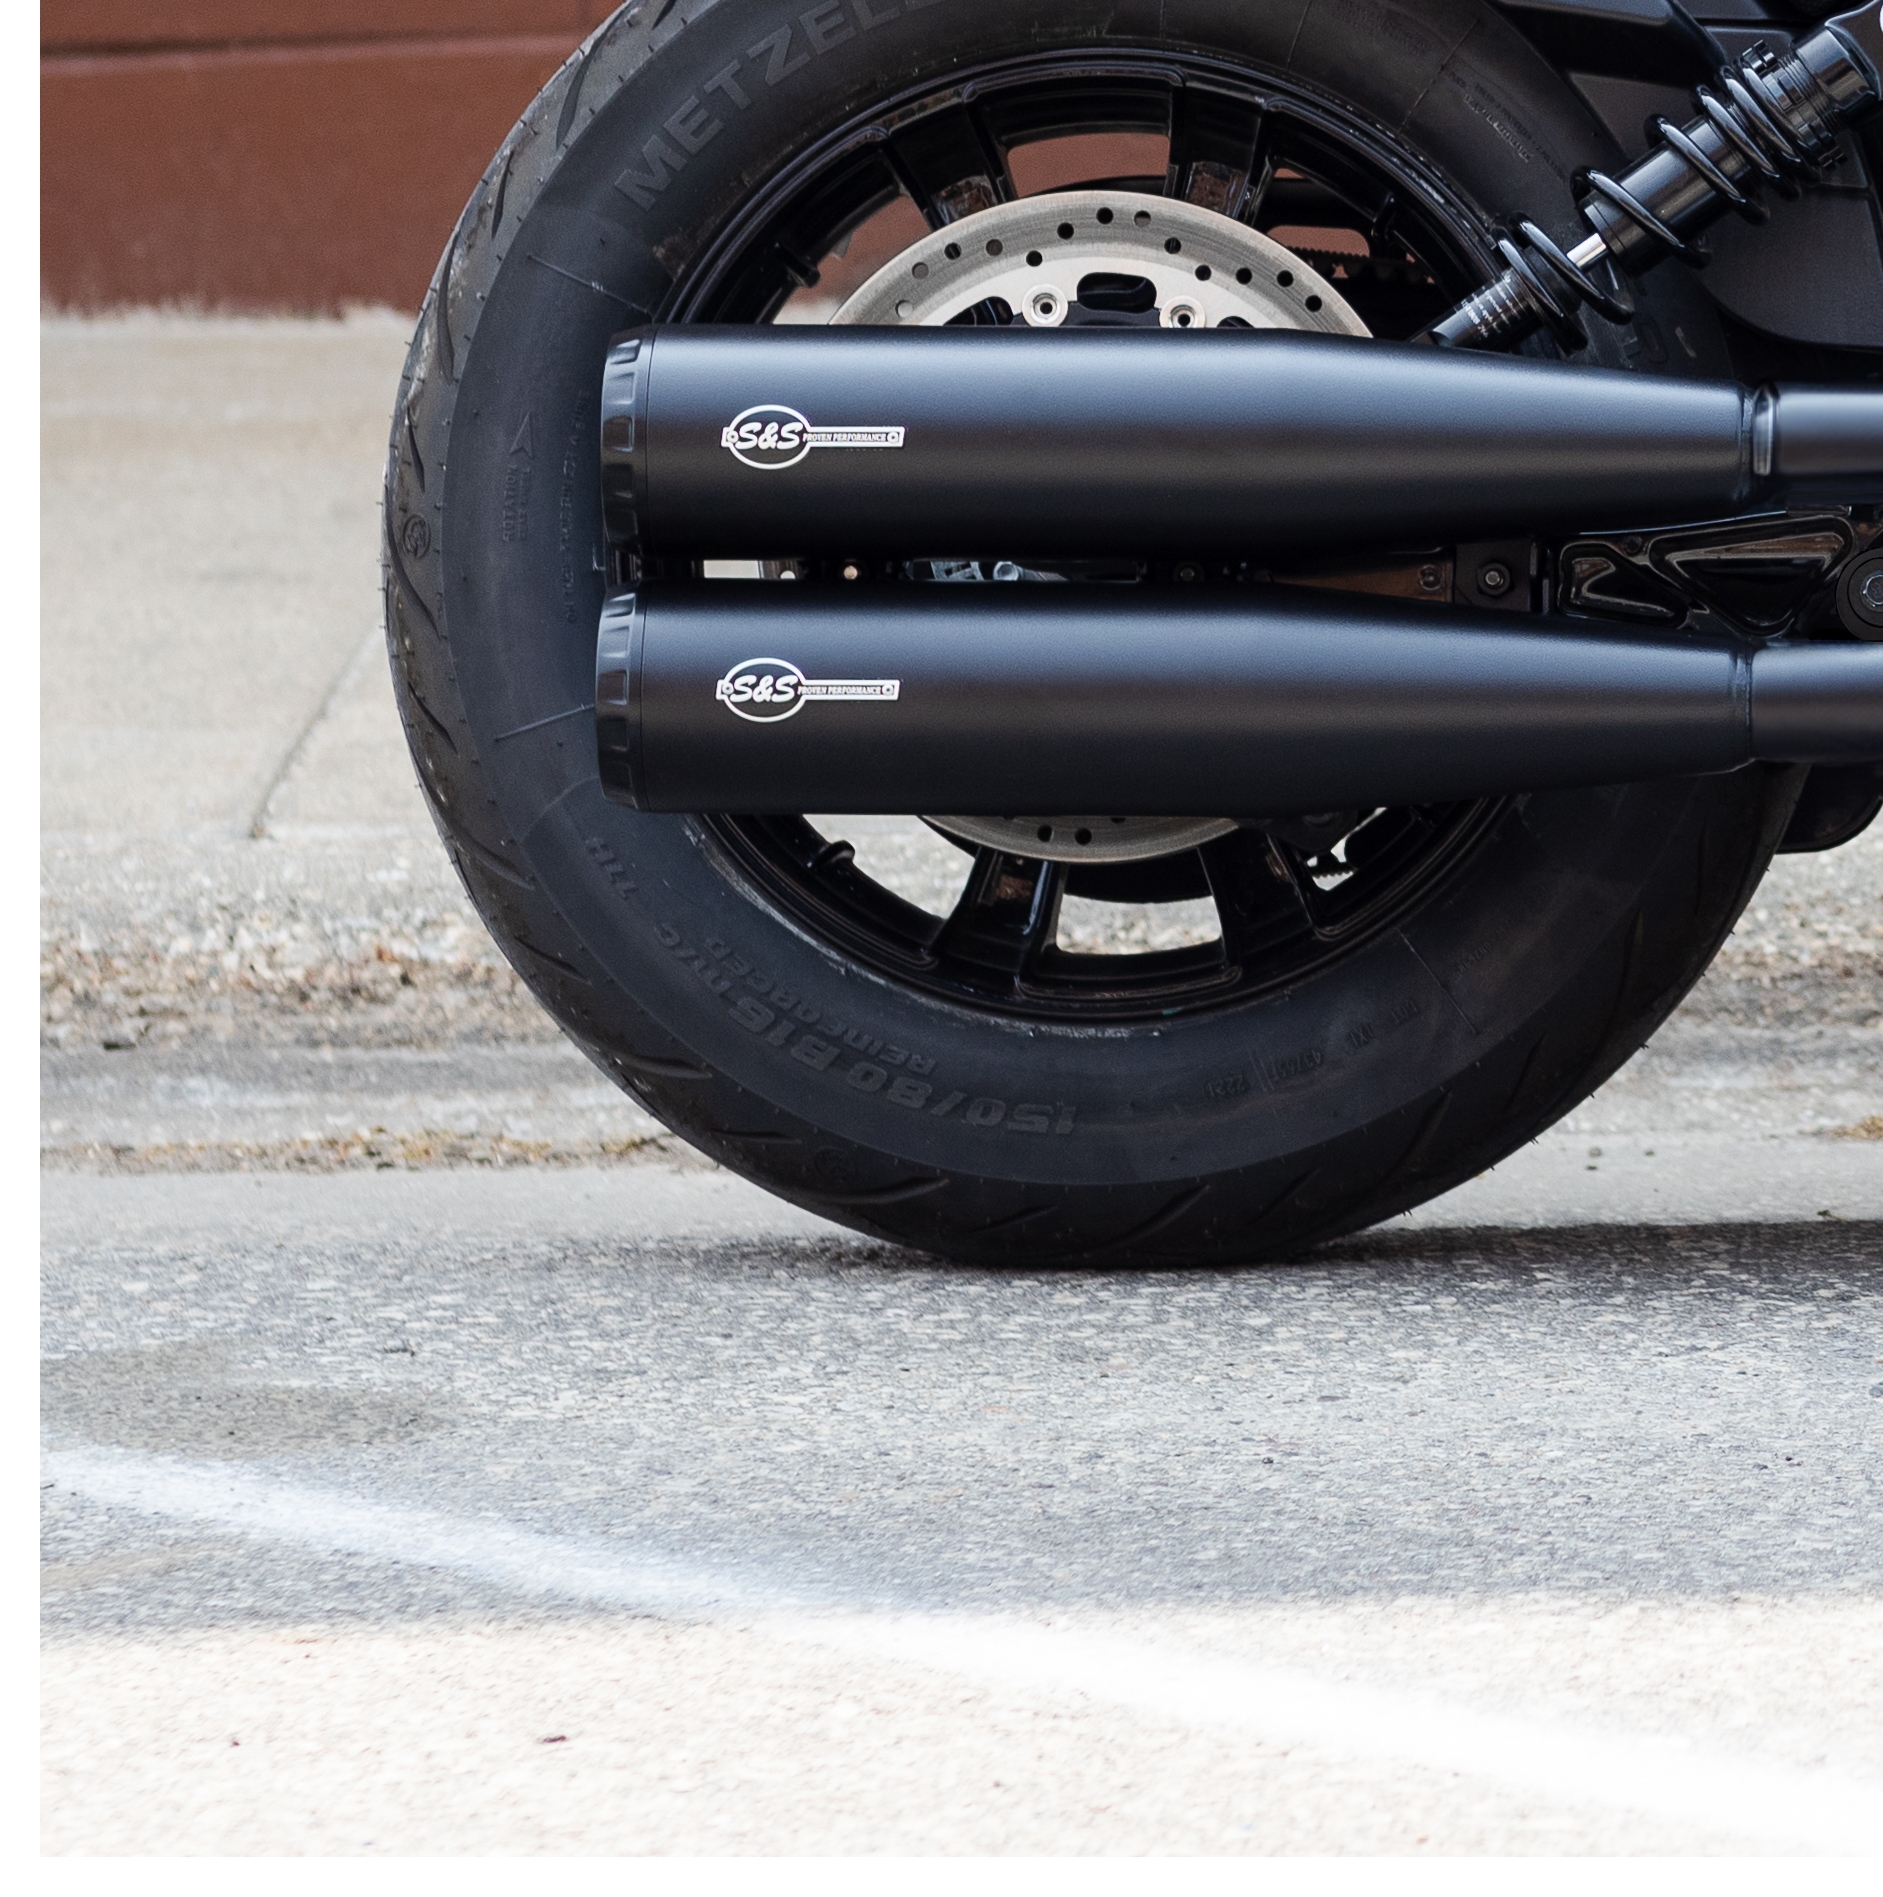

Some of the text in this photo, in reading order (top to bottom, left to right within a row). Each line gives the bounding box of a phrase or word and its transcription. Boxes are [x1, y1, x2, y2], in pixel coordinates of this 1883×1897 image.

[735, 422, 887, 450] S&S PROVEN PERFORMANCE
[730, 675, 882, 703] S&S PROVEN PERFORMANCE
[725, 989, 840, 1076] B16
[843, 1056, 1078, 1134] 150/80
